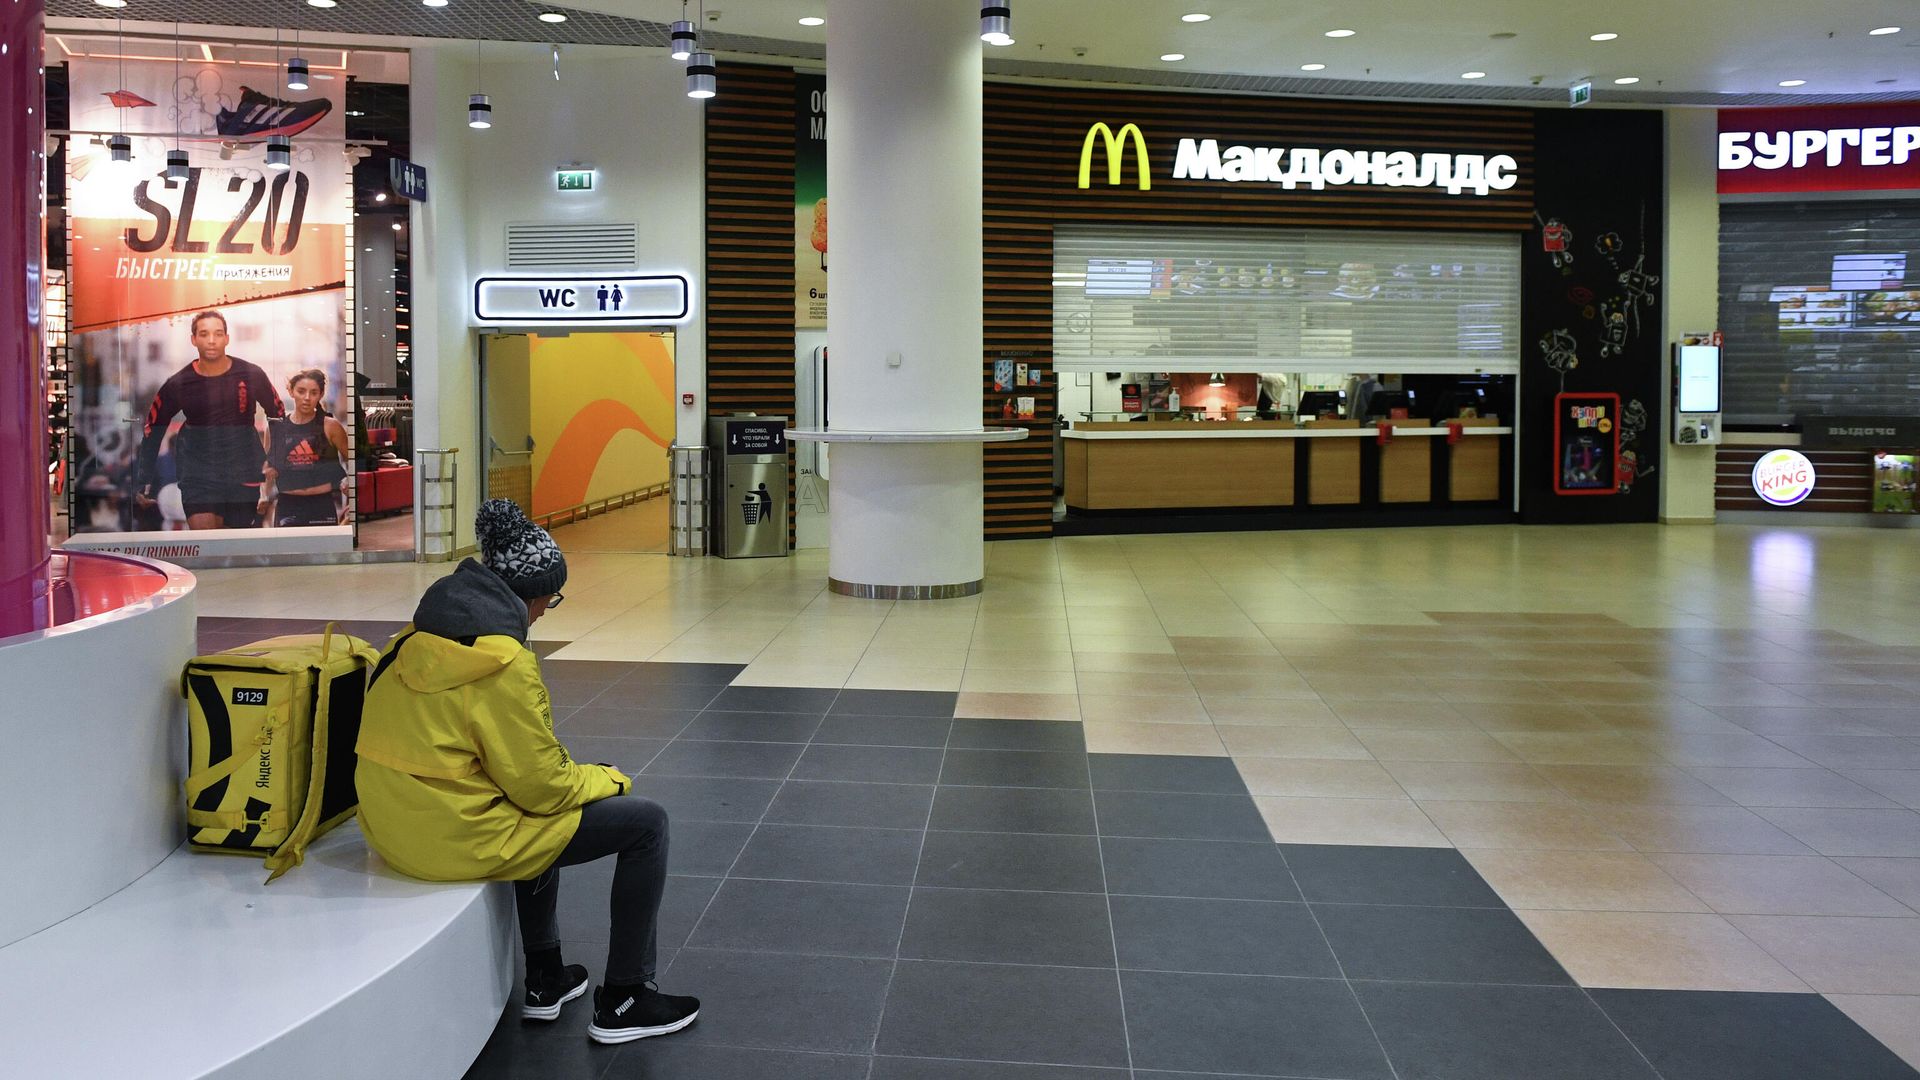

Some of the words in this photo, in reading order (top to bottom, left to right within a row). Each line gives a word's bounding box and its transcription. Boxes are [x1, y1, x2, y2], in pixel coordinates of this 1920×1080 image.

[1718, 126, 1920, 170] БУРГЕР
[1173, 138, 1518, 196] Макдоналдс
[116, 257, 213, 281] БЫСТРЕЕ
[539, 288, 576, 308] WC
[810, 288, 817, 299] 6
[1762, 470, 1807, 492] KING
[237, 691, 264, 703] 9129
[255, 749, 272, 789] Яндекс
[615, 996, 635, 1016] PUMA
